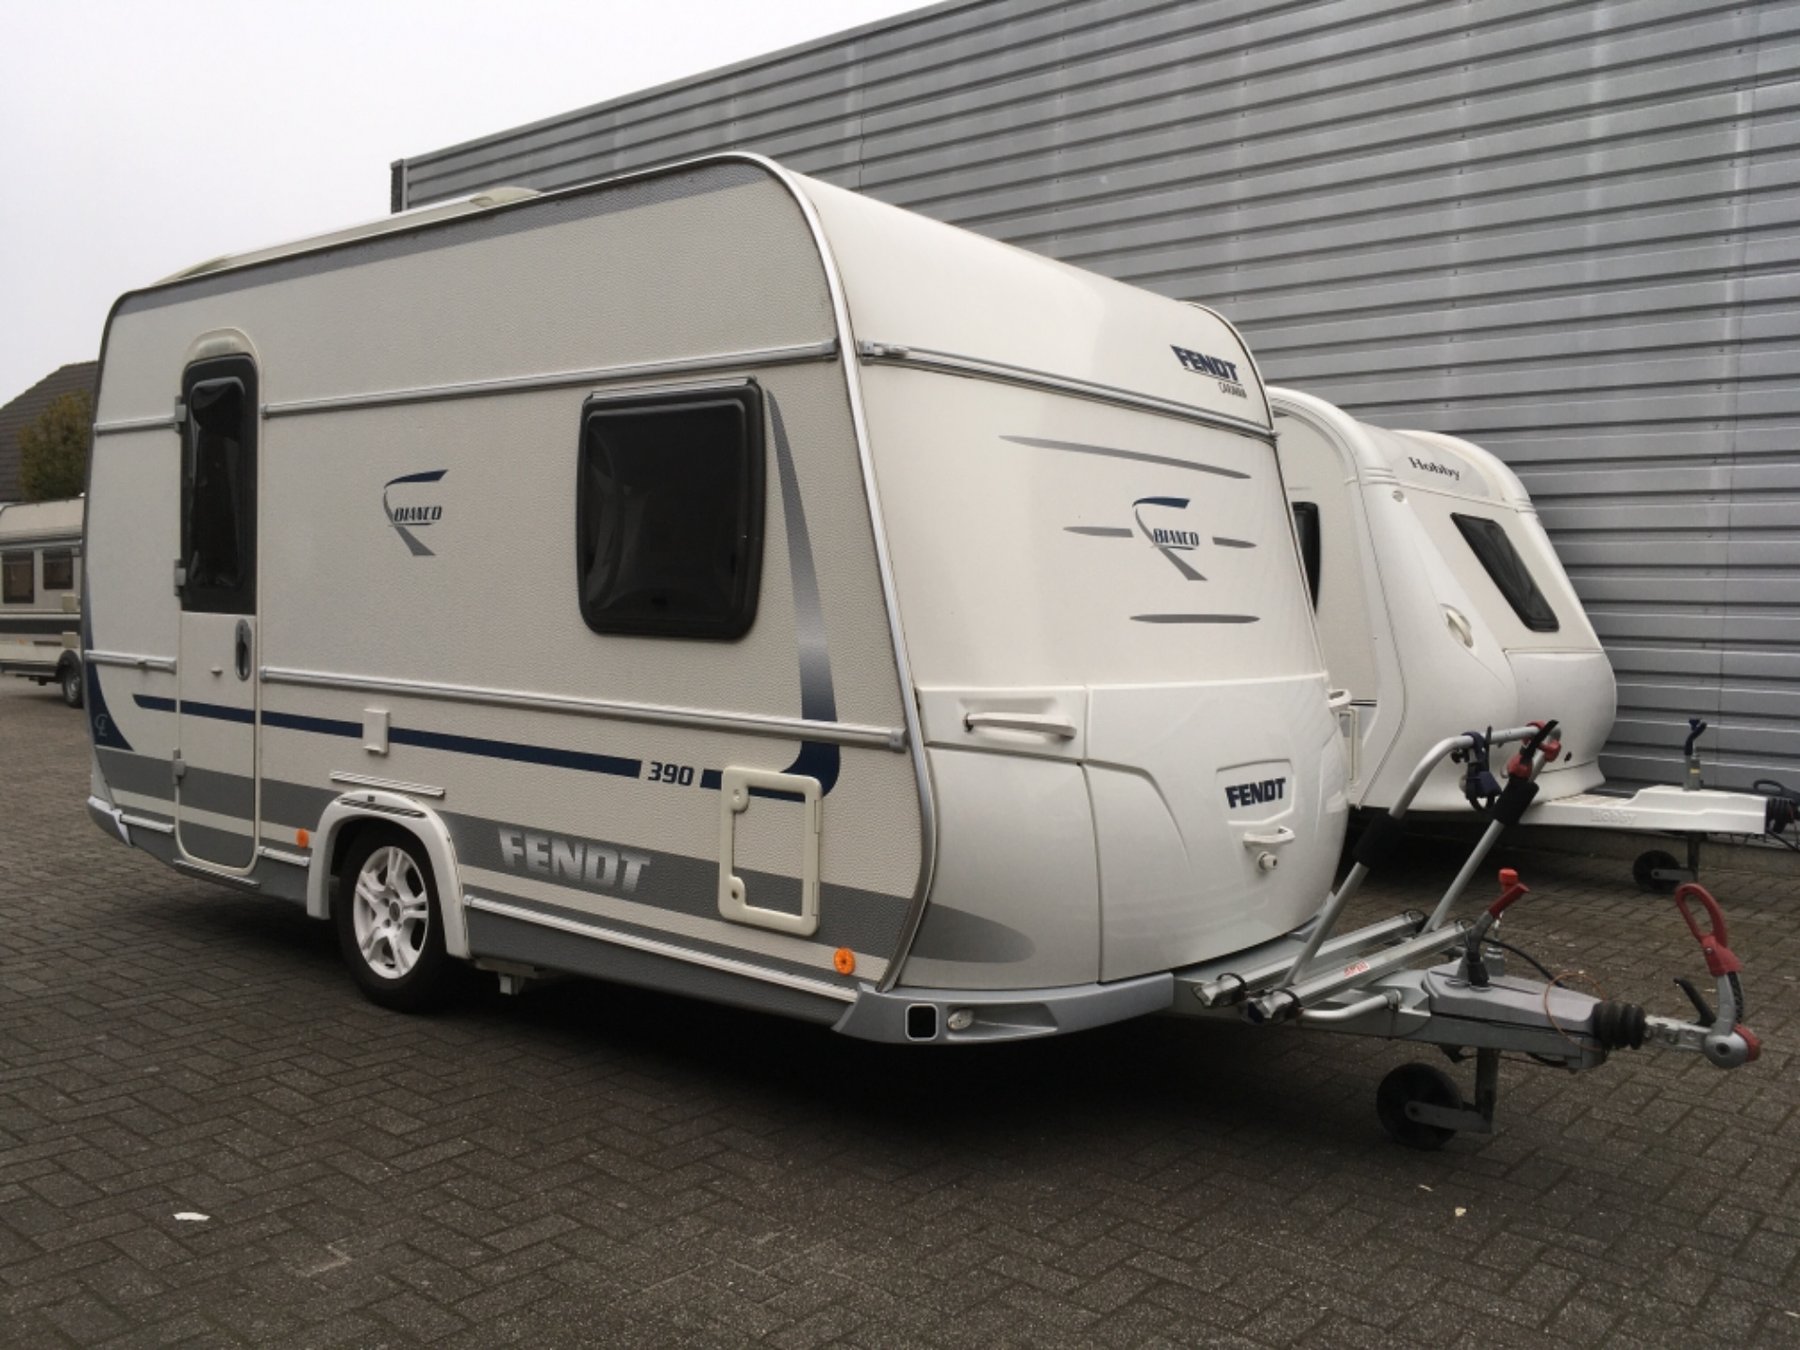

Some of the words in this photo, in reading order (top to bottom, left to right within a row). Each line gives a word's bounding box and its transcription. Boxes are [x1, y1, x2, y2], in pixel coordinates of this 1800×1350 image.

[1170, 344, 1238, 382] FENDT
[1408, 456, 1460, 481] Hobby
[394, 505, 443, 522] BIANCO
[1153, 527, 1200, 547] BIANCO
[647, 761, 695, 787] 390
[1225, 776, 1286, 809] FENDT
[499, 826, 652, 892] FENDT
